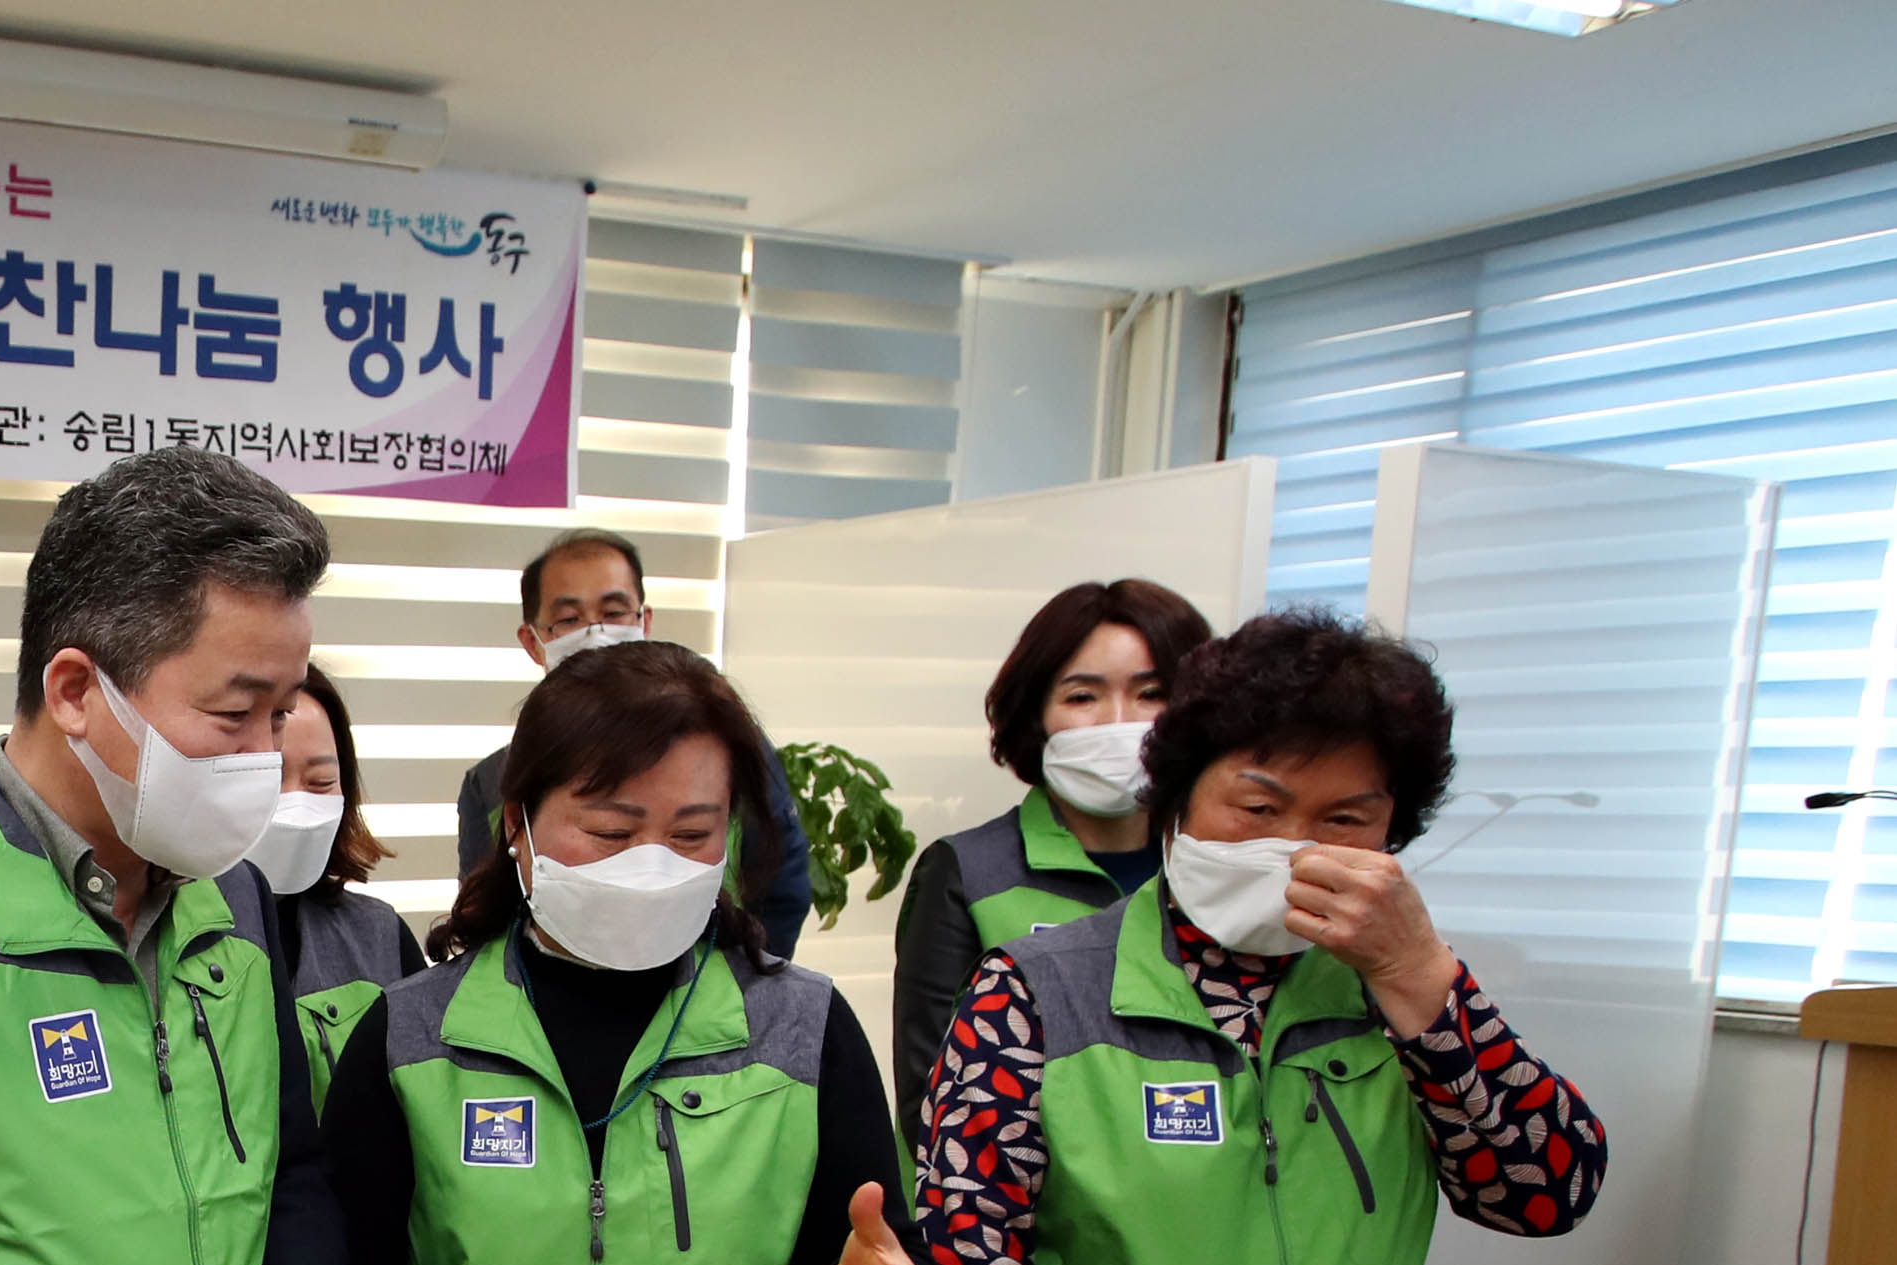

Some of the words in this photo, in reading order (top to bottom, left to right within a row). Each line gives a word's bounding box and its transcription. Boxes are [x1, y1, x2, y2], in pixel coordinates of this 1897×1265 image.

[270, 197, 316, 225] 새로운
[479, 211, 530, 275] 동구
[323, 281, 505, 401] 행사
[48, 1049, 100, 1082] 희망지기
[1153, 1111, 1212, 1130] 희망지기
[471, 1130, 526, 1152] 희망지기
